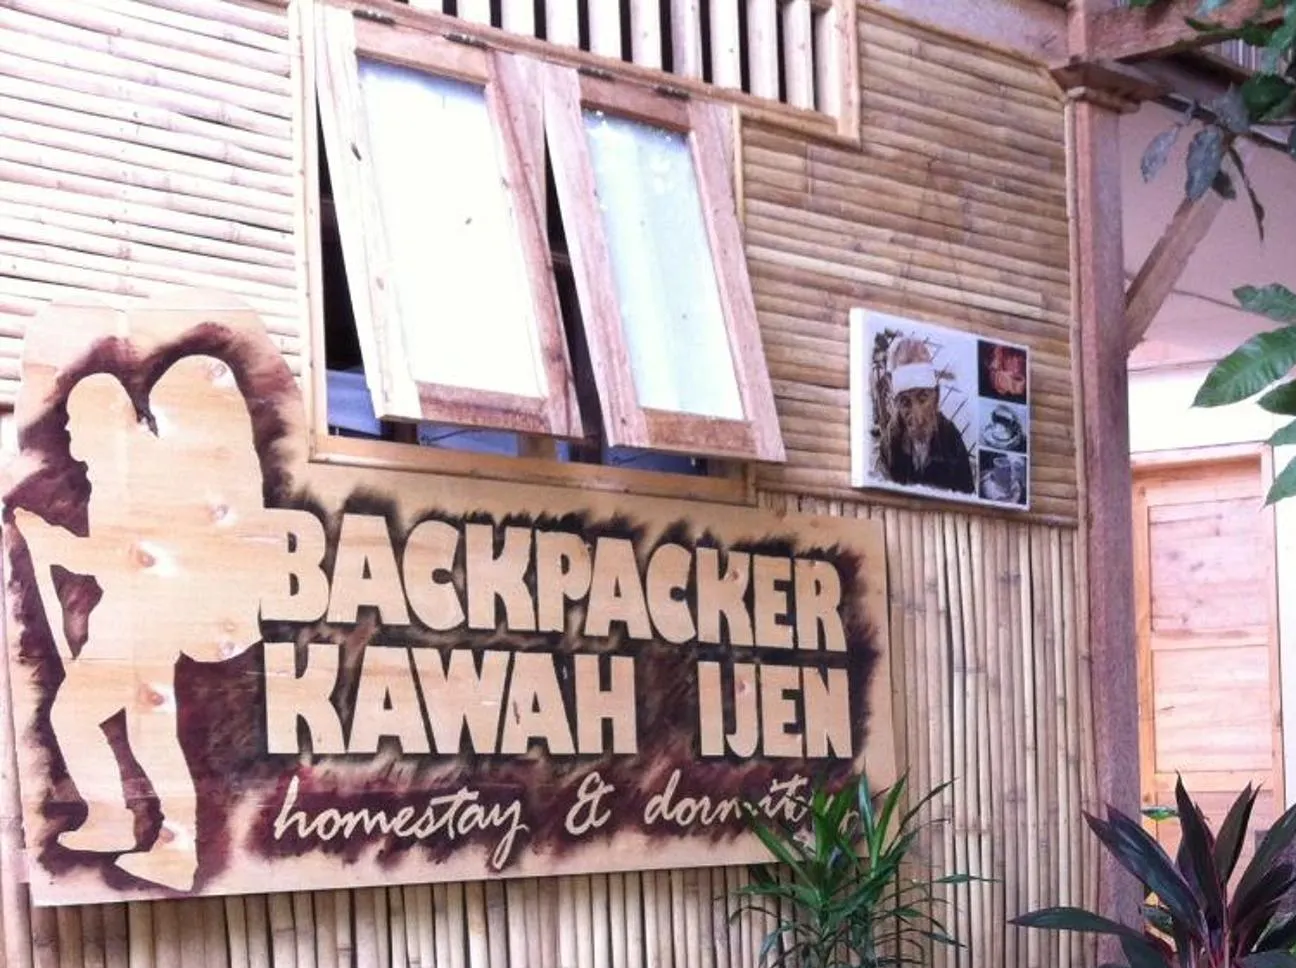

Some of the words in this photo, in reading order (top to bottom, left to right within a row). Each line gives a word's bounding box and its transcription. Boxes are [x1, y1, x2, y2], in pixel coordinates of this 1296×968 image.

[258, 508, 848, 652] BACKPACKER
[264, 642, 637, 754] KAWAH
[697, 661, 853, 758] IJEN
[274, 775, 530, 870] homestay
[564, 771, 615, 836] &
